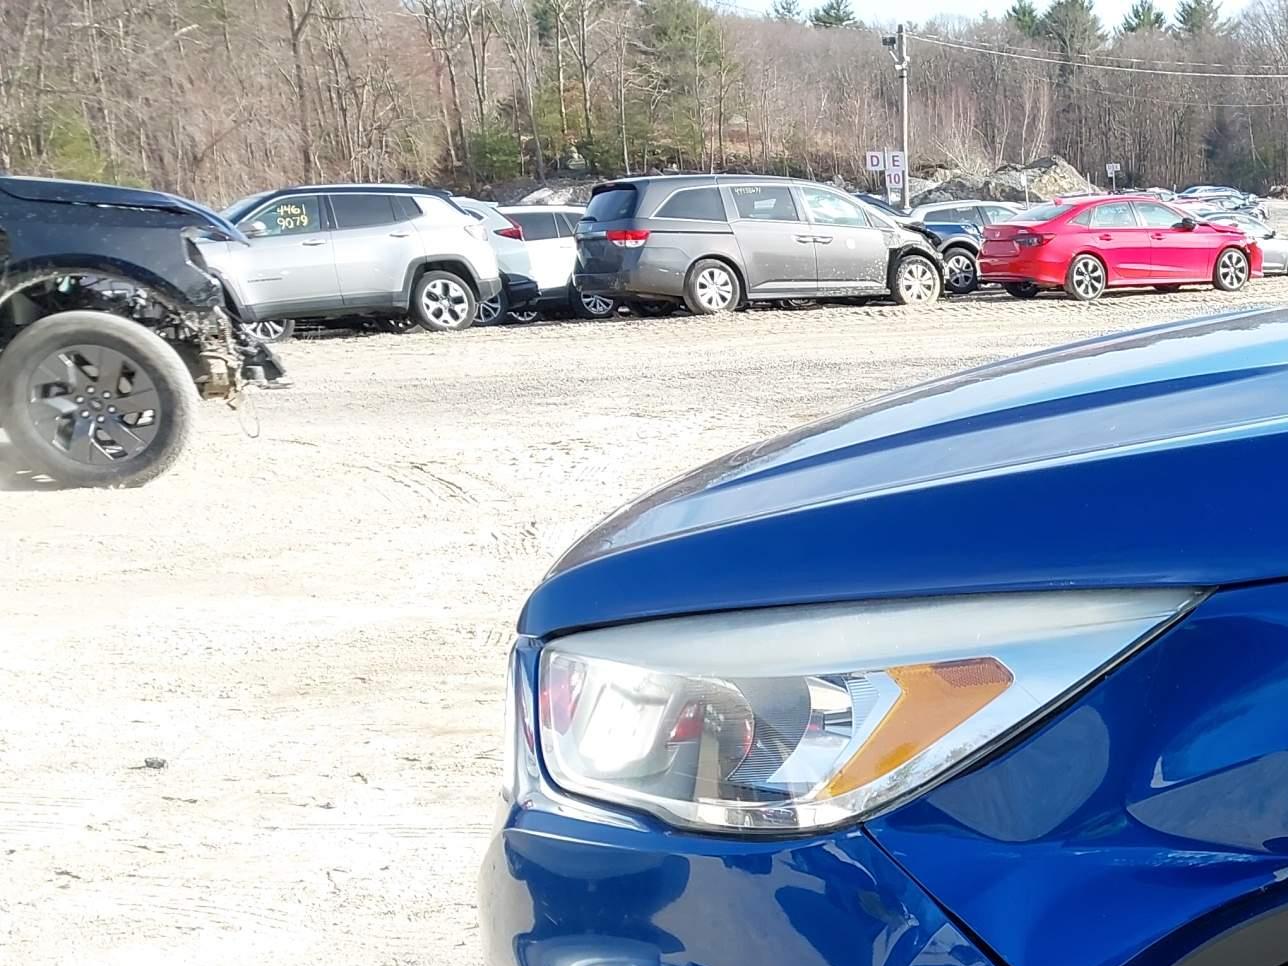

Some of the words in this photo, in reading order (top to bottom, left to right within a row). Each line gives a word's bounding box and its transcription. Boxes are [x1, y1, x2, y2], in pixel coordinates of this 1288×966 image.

[870, 154, 880, 167] D
[891, 154, 901, 168] E
[886, 173, 901, 185] 10
[277, 203, 306, 216] 4461
[277, 215, 308, 230] 9079
